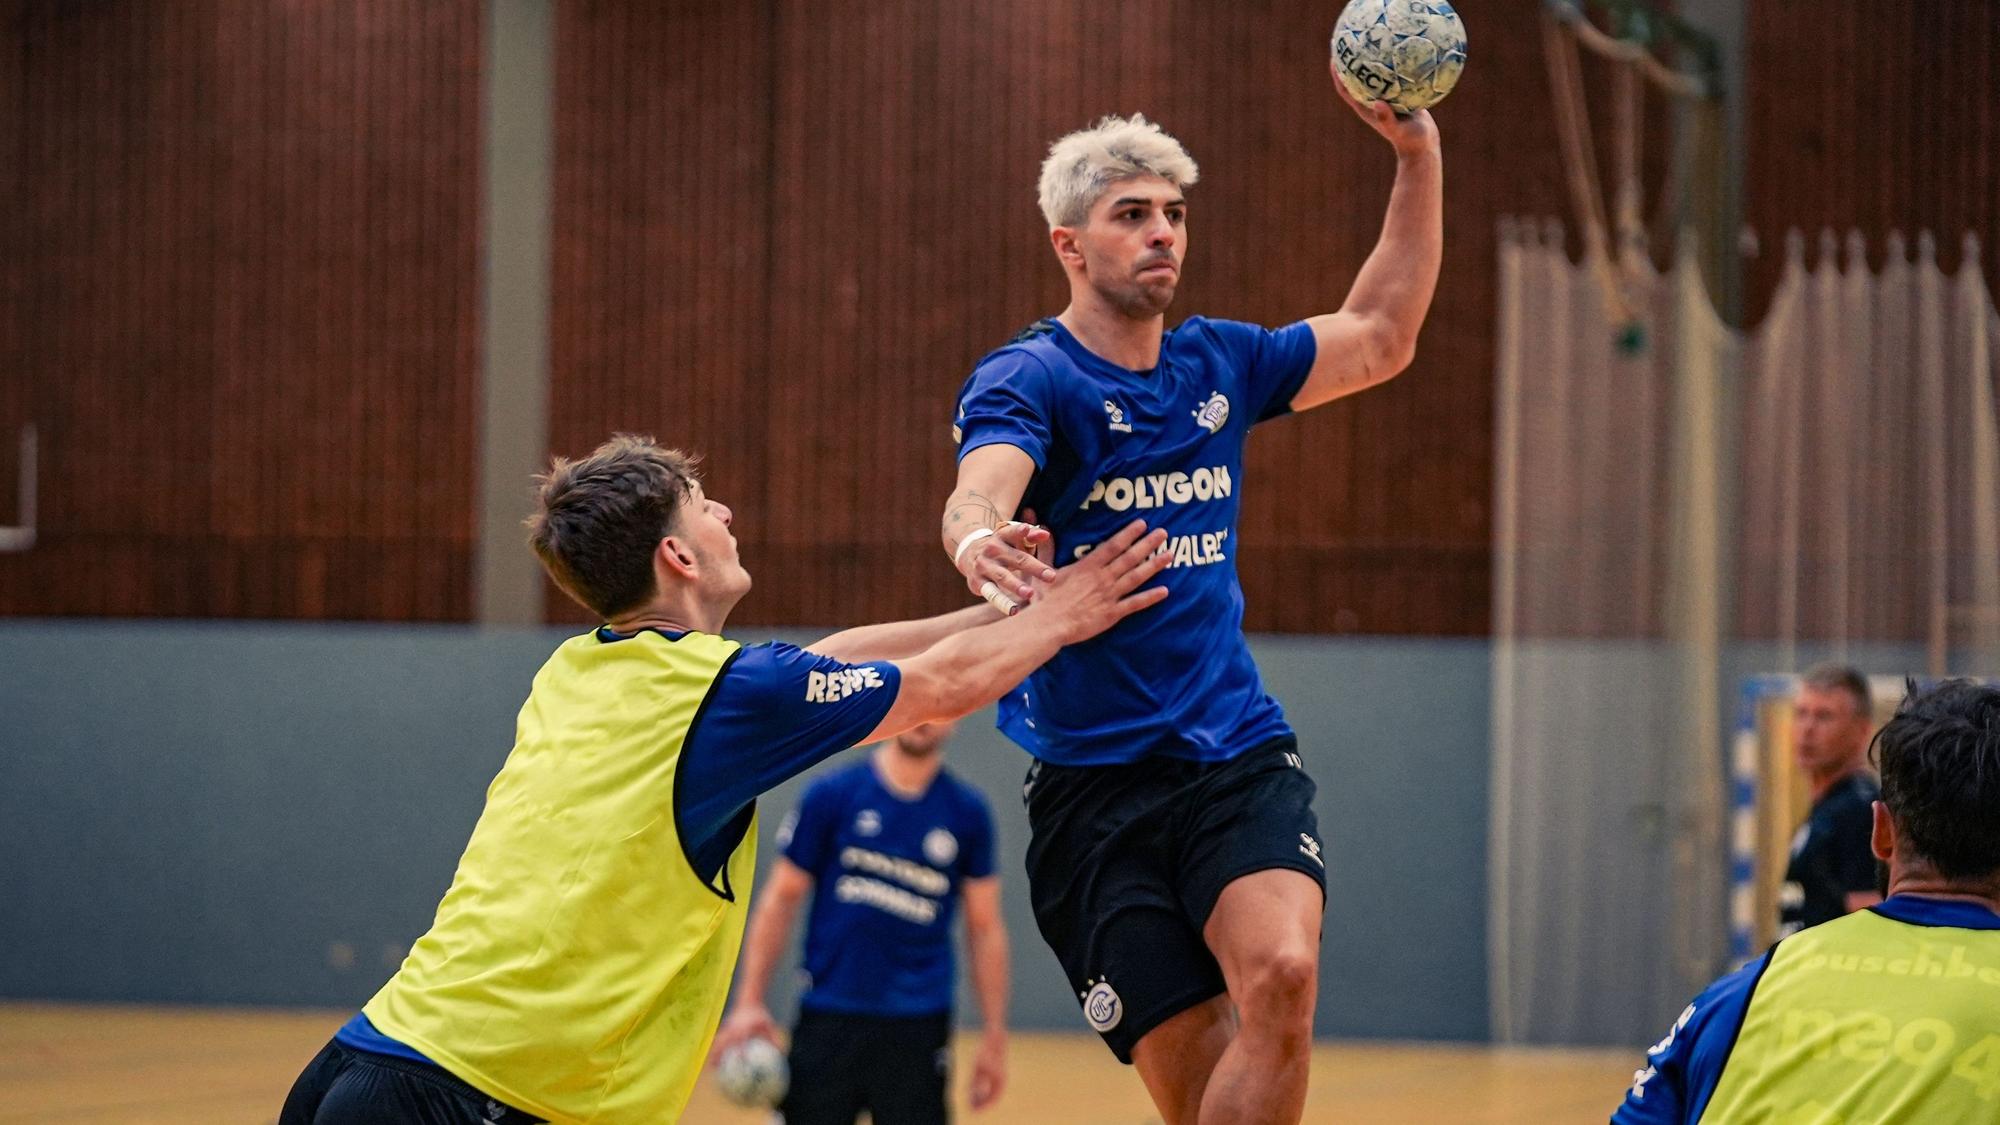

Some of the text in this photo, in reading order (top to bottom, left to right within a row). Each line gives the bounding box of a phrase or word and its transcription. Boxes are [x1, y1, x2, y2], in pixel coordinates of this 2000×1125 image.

[1336, 37, 1394, 95] SELECT
[1079, 465, 1232, 512] POLYGON
[806, 666, 884, 704] REWE
